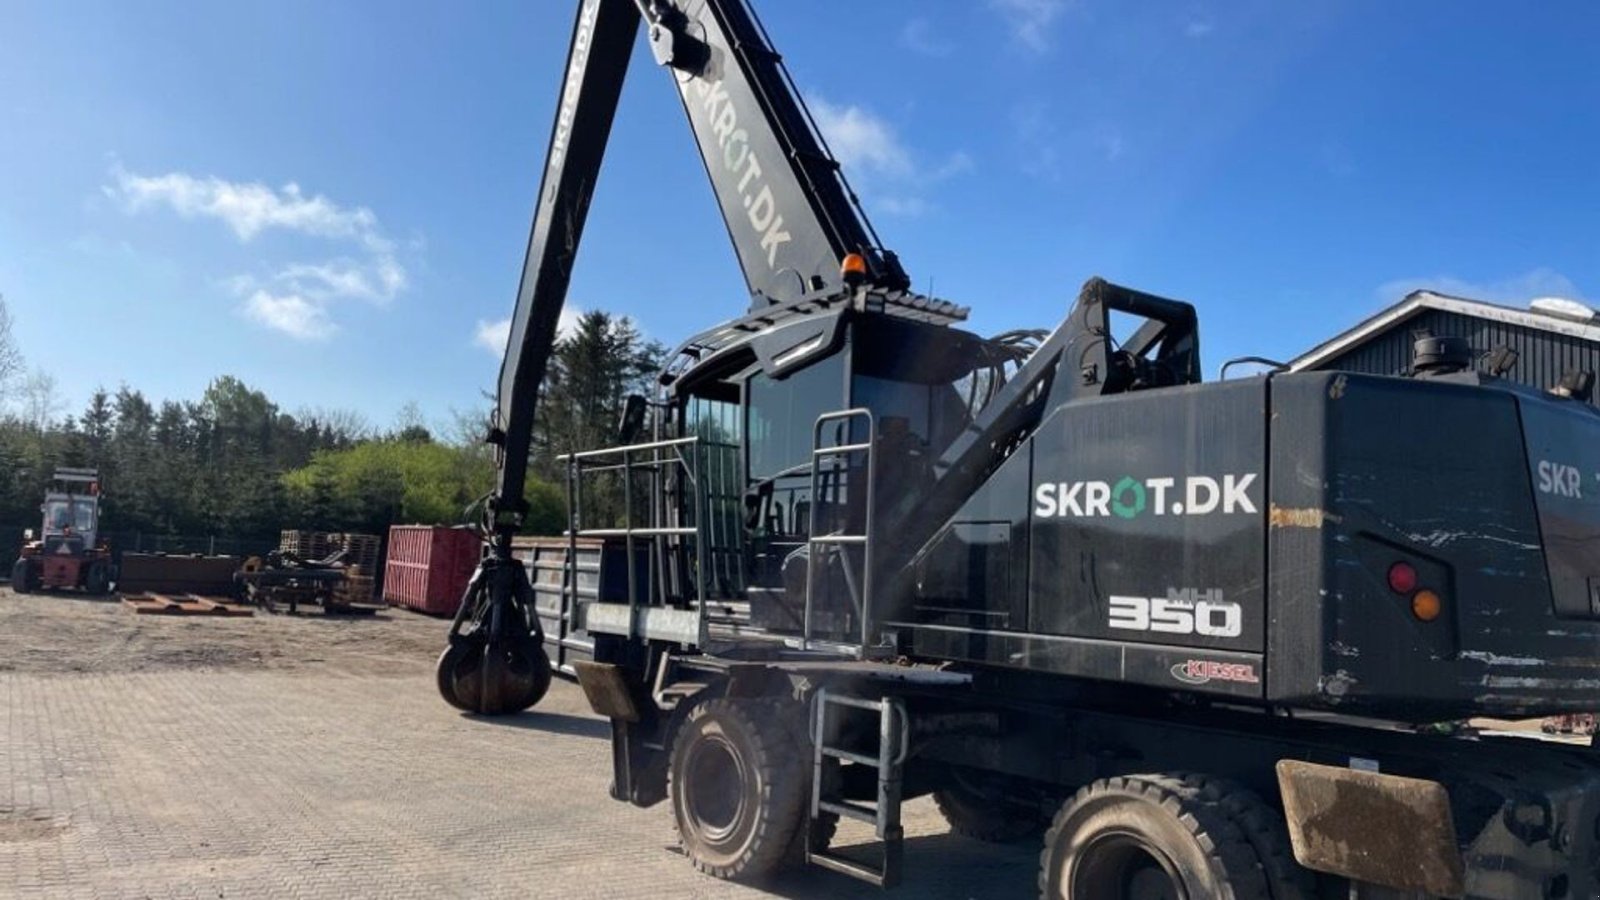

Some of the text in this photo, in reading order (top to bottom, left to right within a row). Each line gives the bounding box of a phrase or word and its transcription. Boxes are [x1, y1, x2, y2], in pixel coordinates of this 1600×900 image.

[1034, 474, 1259, 520] SKROT.DK
[1538, 460, 1600, 499] SKR
[1109, 595, 1242, 638] 350
[1187, 659, 1260, 684] KIESEL
